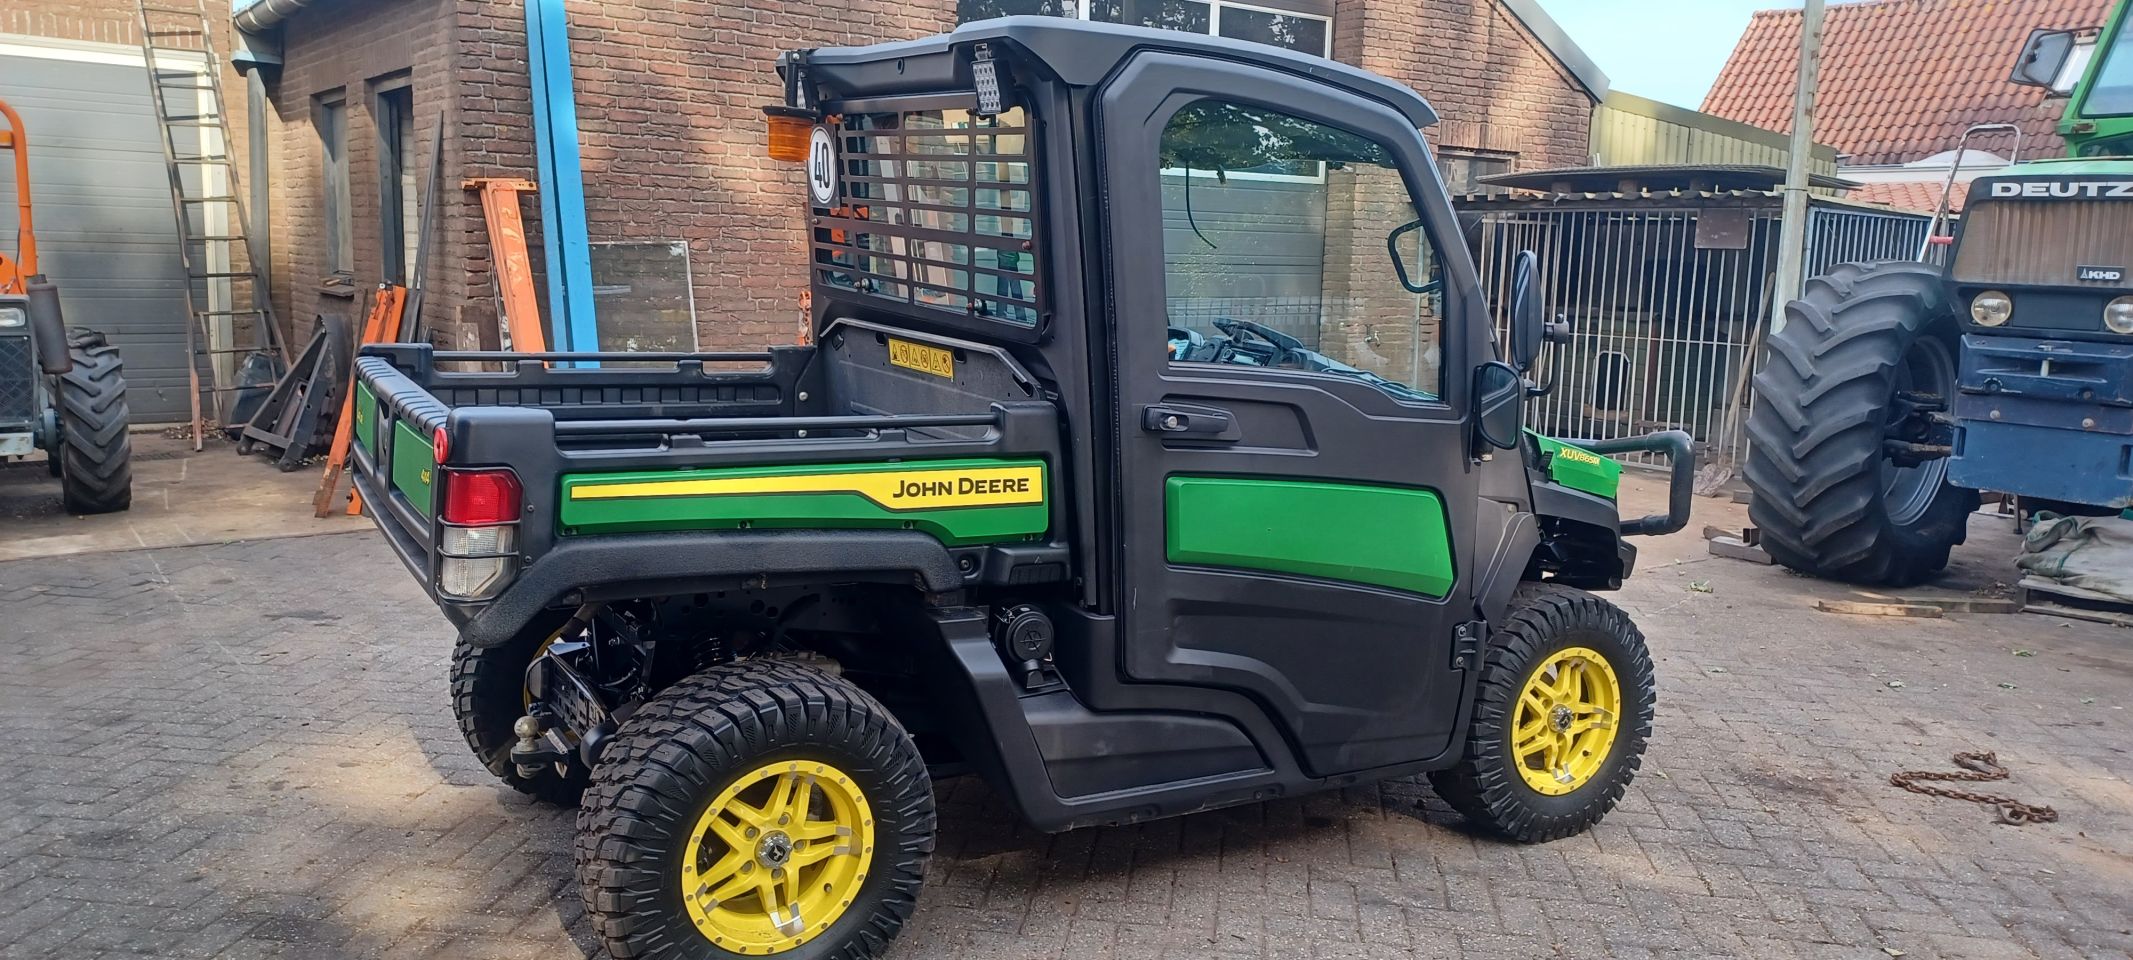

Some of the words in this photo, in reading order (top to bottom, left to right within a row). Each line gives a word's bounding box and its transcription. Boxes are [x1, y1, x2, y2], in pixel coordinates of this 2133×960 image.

[814, 141, 830, 189] 40
[1991, 181, 2133, 198] DEUTZ
[2088, 270, 2120, 280] KHD
[892, 479, 953, 498] JOHN
[958, 477, 1030, 495] DEERE
